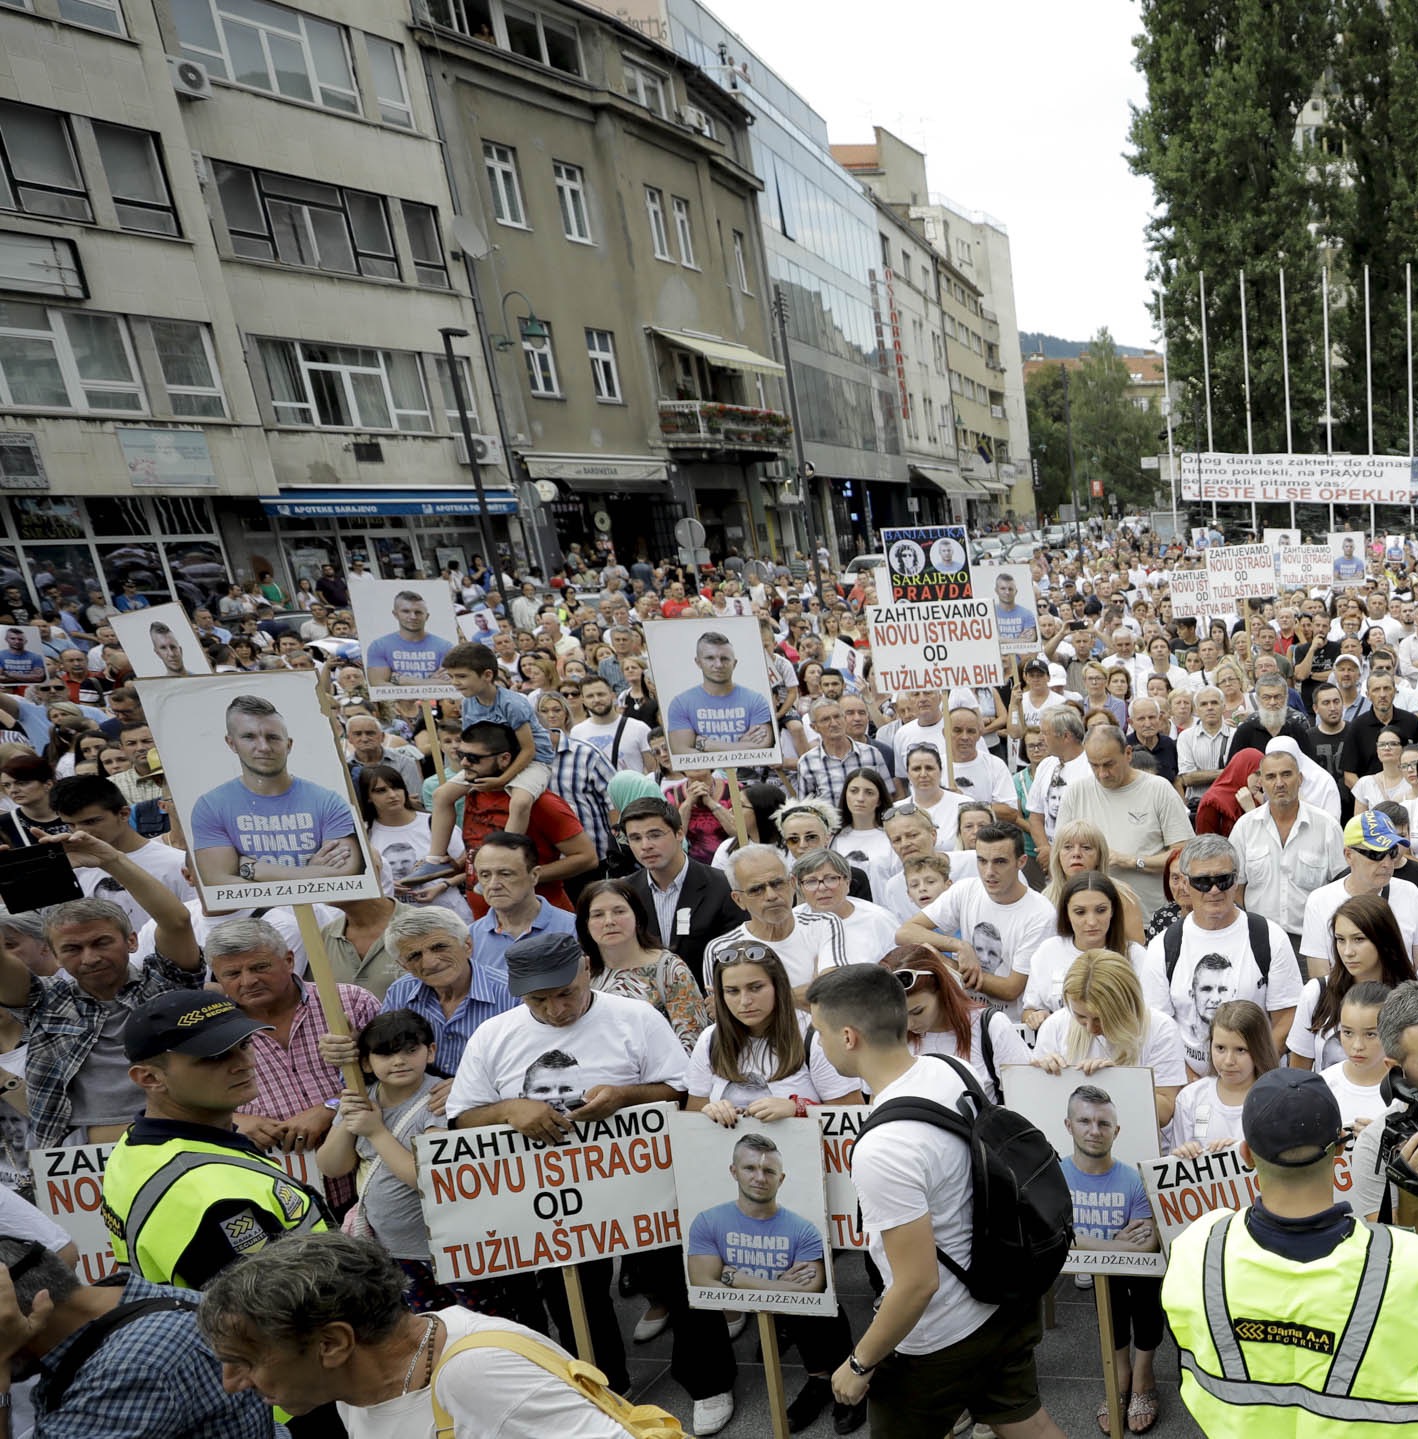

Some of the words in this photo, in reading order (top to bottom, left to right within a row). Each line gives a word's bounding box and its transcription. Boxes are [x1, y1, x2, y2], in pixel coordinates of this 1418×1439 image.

[1182, 455, 1221, 467] Onog
[1226, 456, 1262, 466] dana
[1266, 458, 1284, 466] se
[1366, 460, 1412, 469] danas
[1183, 466, 1227, 475] nismo
[1232, 466, 1293, 477] poklekli,
[1298, 469, 1315, 477] na
[1319, 469, 1384, 478] PRAVDU
[1183, 477, 1199, 485] se
[1260, 478, 1311, 488] pitamo
[1262, 487, 1280, 500] LI
[1285, 487, 1312, 500] SE
[335, 505, 377, 514] SARAJEVO
[884, 530, 927, 542] BANJA
[929, 527, 965, 539] LUKA
[1209, 545, 1270, 559] ZAHTIJEVAMO
[1283, 546, 1331, 554] ZAHTIJEVAMO
[1210, 559, 1233, 573] NOVU
[1235, 556, 1272, 570] ISTRAGU
[1283, 555, 1301, 564] NOVU
[1302, 554, 1331, 564] ISTRAGU
[1301, 564, 1312, 572] OD
[892, 571, 969, 586] SARAJEVO
[1171, 573, 1208, 582] ZAHTIJE
[1234, 571, 1248, 582] OD
[1321, 574, 1332, 583] BIH
[894, 583, 973, 601] PRAVDA
[1171, 581, 1195, 593] NOVU
[1261, 583, 1274, 595] BIH
[1196, 592, 1209, 602] OD
[873, 602, 988, 623] ZAHTIJEVAMO
[1221, 602, 1234, 613] BIH
[874, 623, 919, 646] NOVU
[924, 618, 993, 644] ISTRAGU
[392, 651, 436, 660] GRAND
[923, 645, 948, 662] OD
[392, 661, 436, 672] FINALS
[880, 663, 971, 691] TUŽILAŠTVA
[973, 664, 999, 686] BIH
[696, 707, 746, 719] GRAND
[697, 720, 746, 733] FINALS
[679, 755, 715, 765] PRAVDA
[717, 754, 728, 763] ZA
[730, 751, 773, 762] DŽENANA
[236, 812, 314, 832] GRAND
[239, 832, 318, 852] FINALS
[216, 887, 272, 900] PRAVDA
[275, 885, 293, 896] ZA
[297, 880, 364, 895] DŽENANA
[429, 1108, 666, 1165] ZAHTIVAMO
[431, 1156, 526, 1205] NOVU
[534, 1134, 673, 1189] ISTRAGU
[533, 1188, 583, 1220] OD
[1158, 1179, 1241, 1226] NOVU
[1073, 1207, 1125, 1226] INALS
[443, 1219, 629, 1279] TUŽILAŠTVA
[633, 1209, 682, 1248] BIH
[726, 1231, 790, 1250] GRAND
[726, 1247, 789, 1268] FINALS
[1083, 1255, 1097, 1265] ZA
[1101, 1254, 1157, 1267] DŽENANA
[698, 1290, 745, 1302] PRAVDA
[747, 1293, 763, 1303] ZA
[765, 1293, 823, 1306] DŽENANA
[1267, 1325, 1302, 1338] Gama
[1306, 1331, 1329, 1344] A.A
[1267, 1334, 1330, 1352] SECURITY
